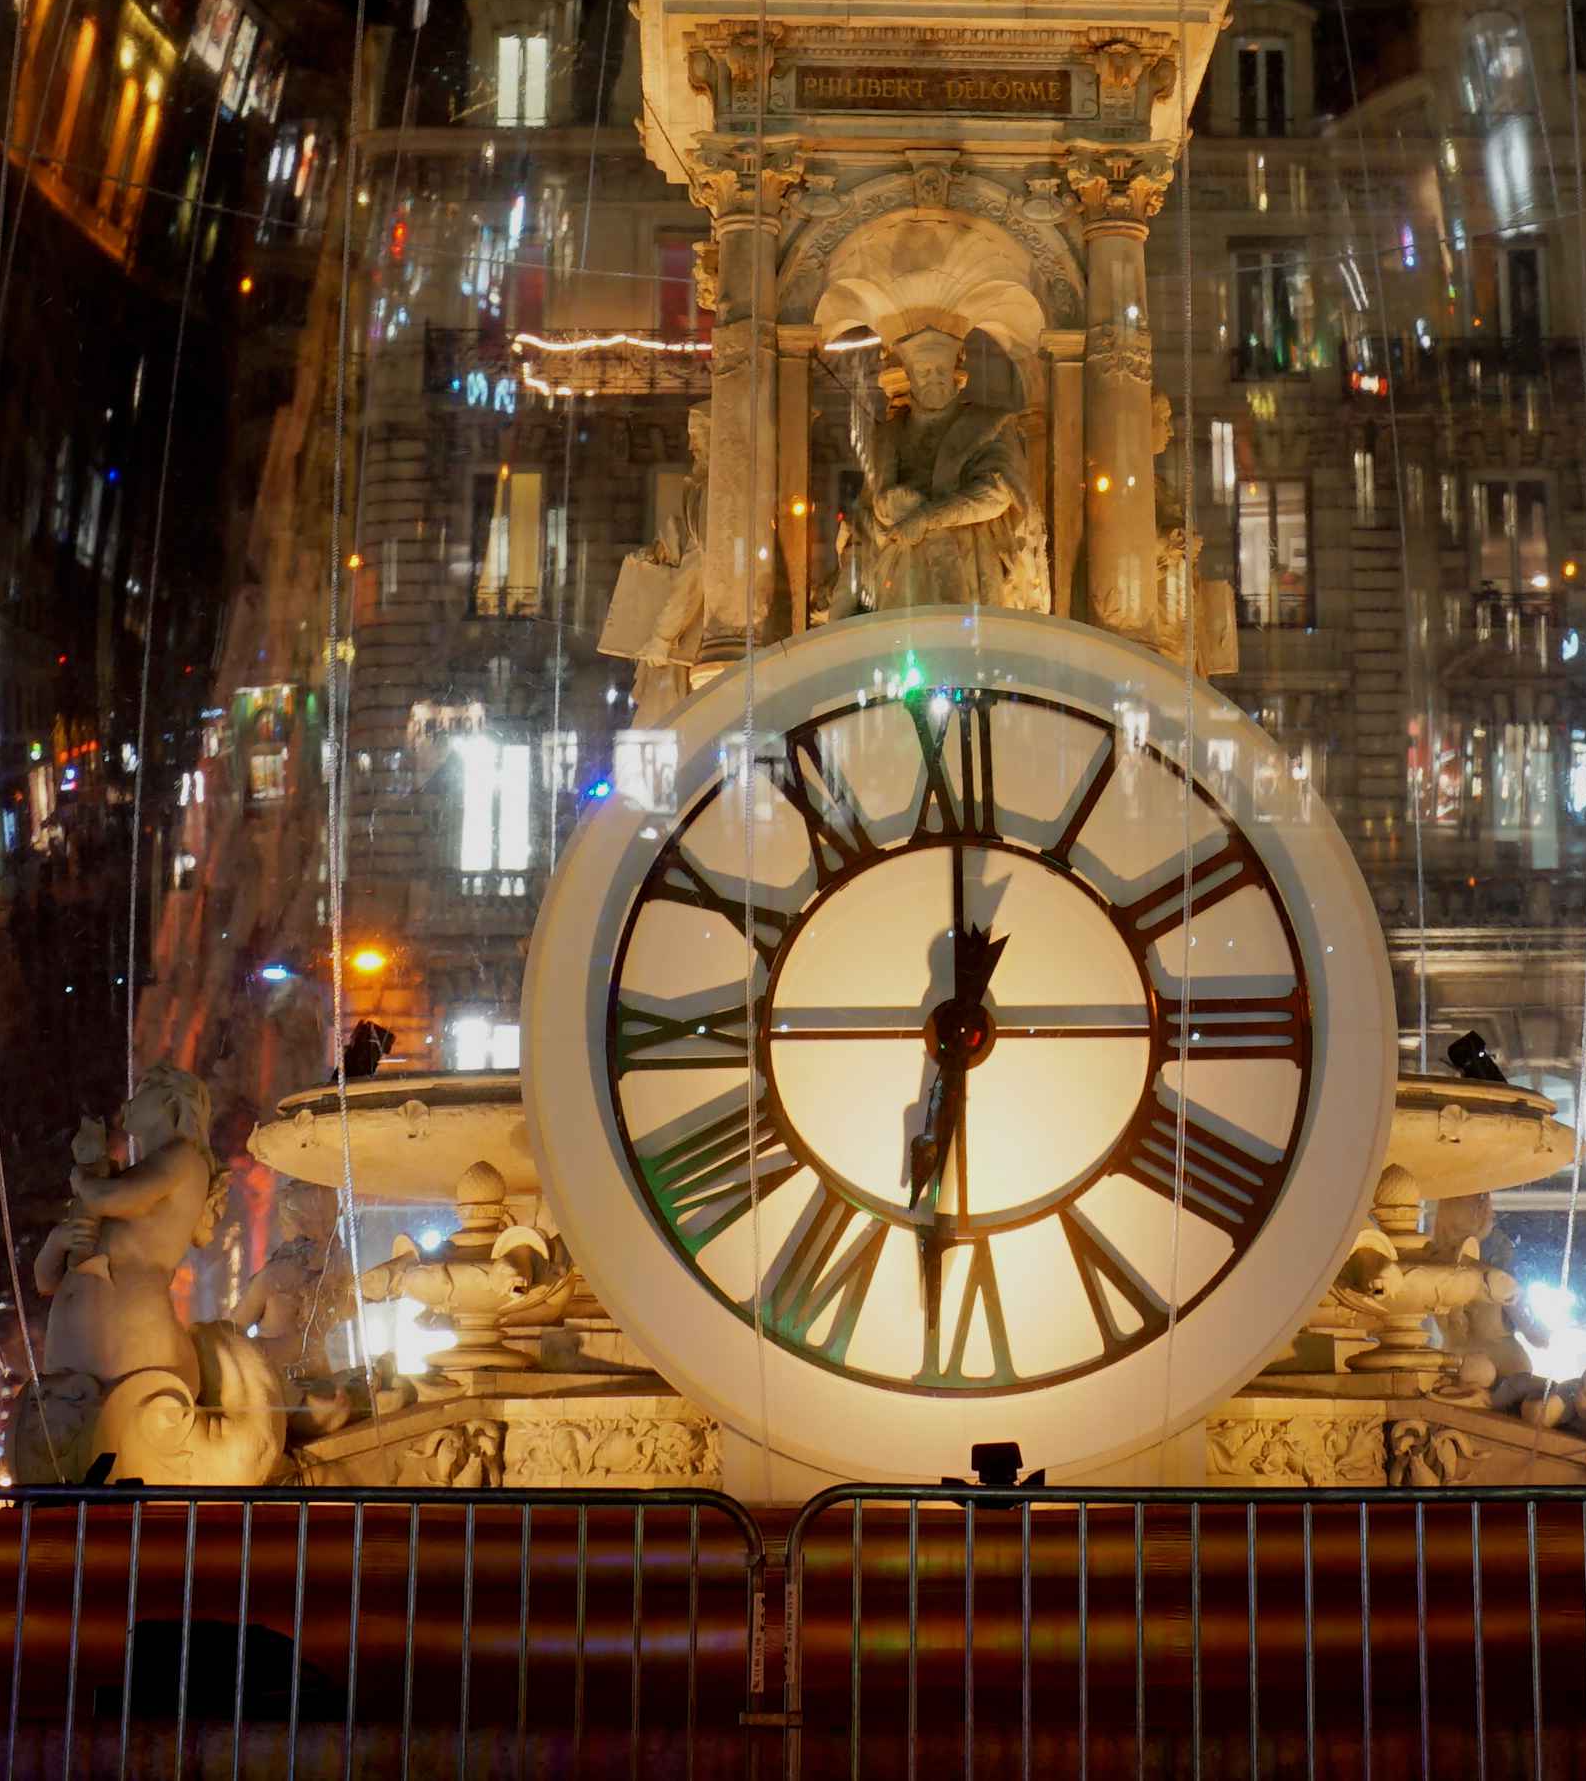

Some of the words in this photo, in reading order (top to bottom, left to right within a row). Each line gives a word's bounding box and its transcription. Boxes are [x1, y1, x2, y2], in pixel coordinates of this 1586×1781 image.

[803, 77, 927, 100] PHILIBERT
[946, 79, 1063, 102] DELORME
[910, 689, 1006, 844] XII
[1042, 726, 1118, 870] I
[644, 843, 792, 963] X
[1130, 832, 1265, 942] II
[618, 999, 764, 1081] IX
[1157, 985, 1310, 1070] III
[636, 1111, 805, 1257] VIII
[1111, 1111, 1288, 1249] IIII
[742, 1190, 889, 1364] VII
[1059, 1206, 1177, 1356] V
